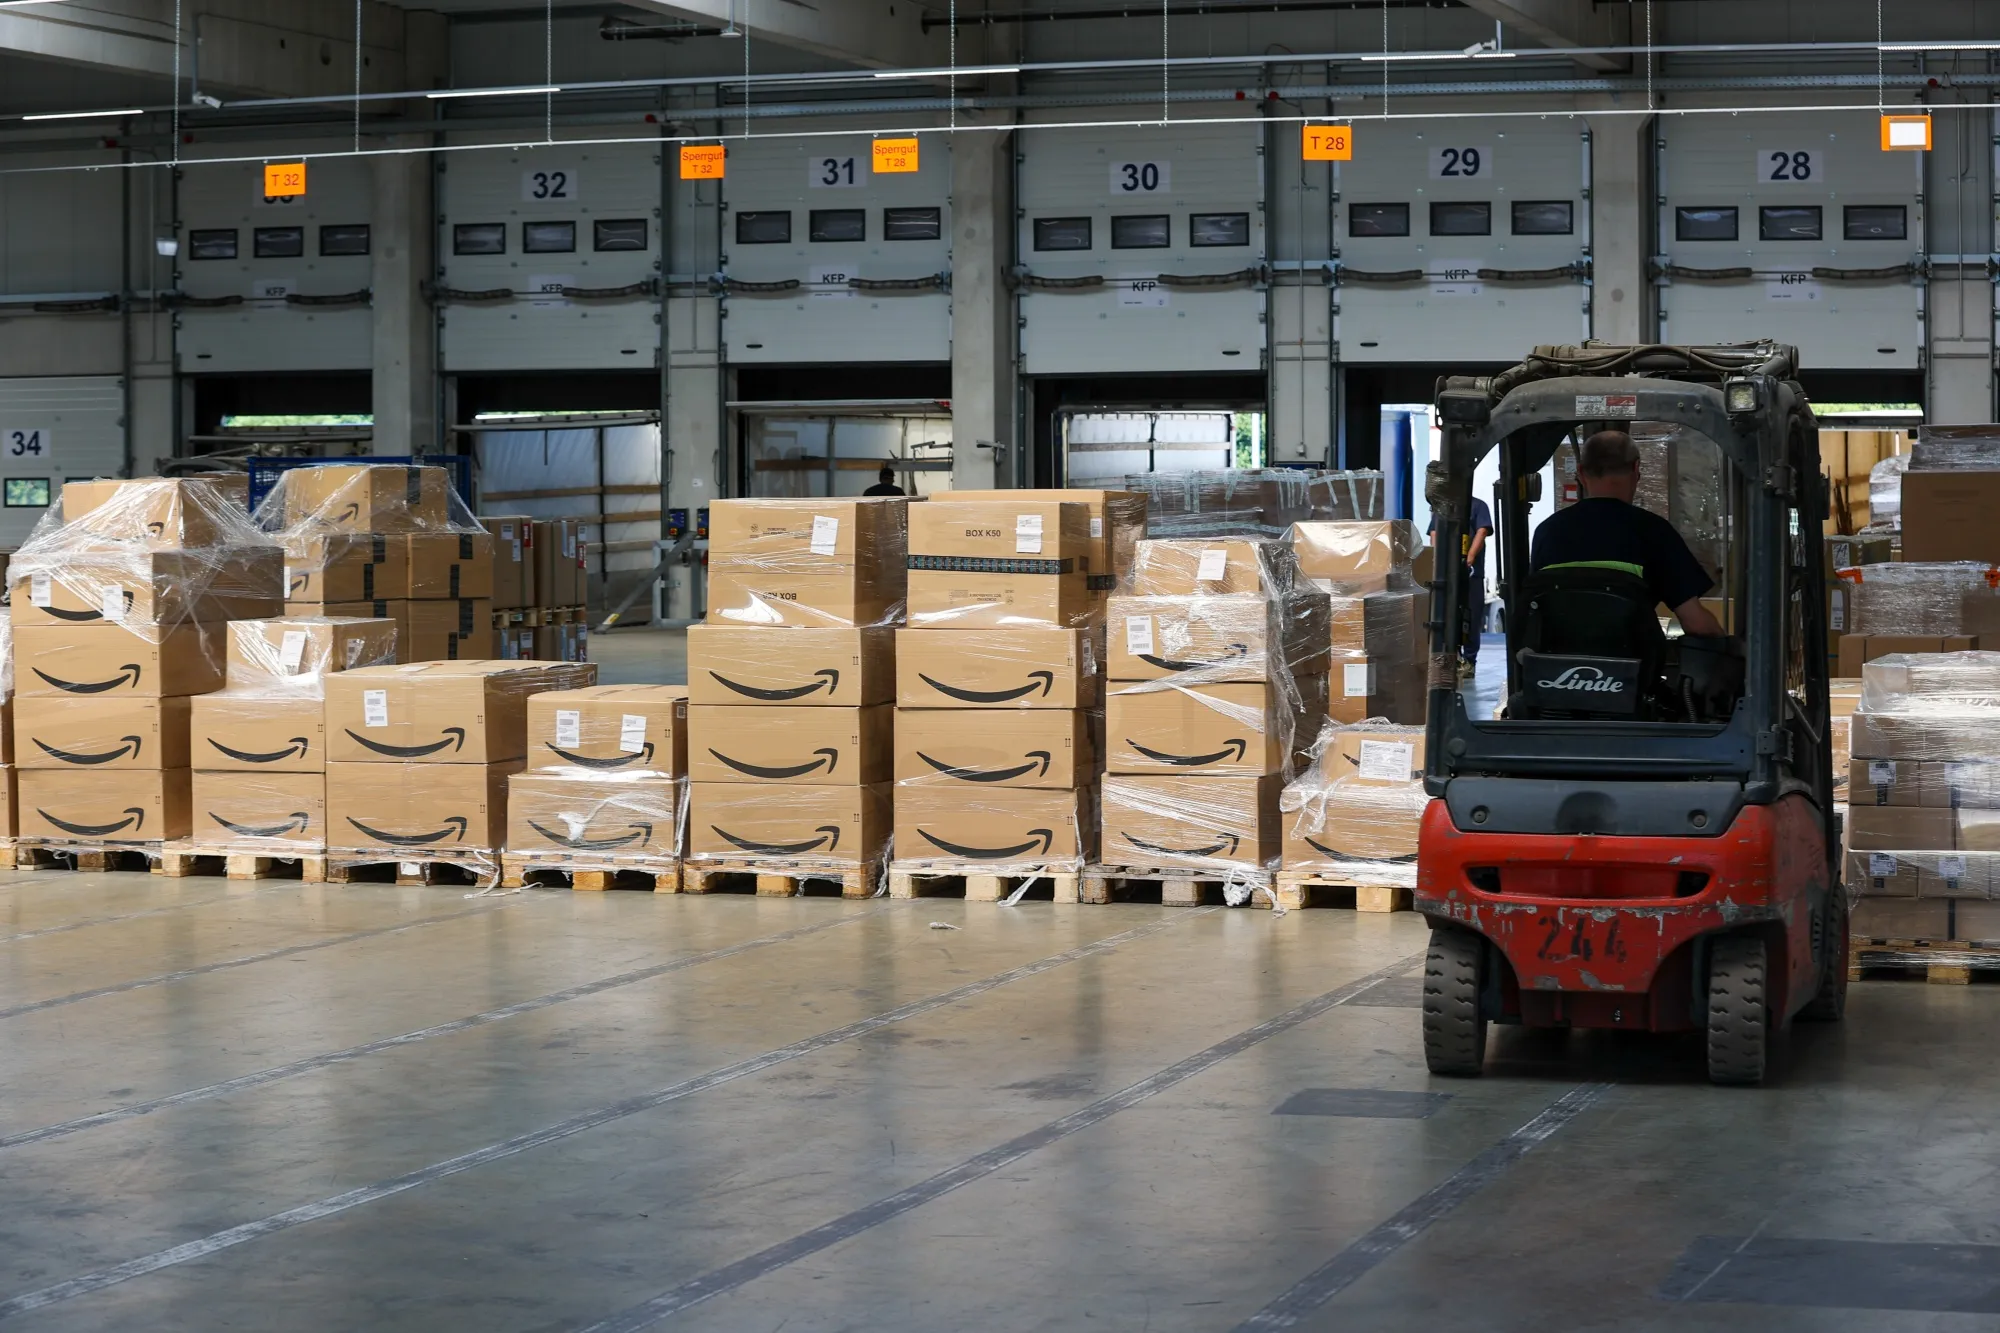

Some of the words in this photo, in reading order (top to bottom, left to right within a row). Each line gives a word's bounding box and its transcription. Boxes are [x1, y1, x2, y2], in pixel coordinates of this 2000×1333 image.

[1310, 136, 1320, 150] T
[1325, 136, 1345, 151] 28
[875, 144, 916, 156] Sperrgut
[682, 151, 723, 163] Sperrgut
[885, 158, 892, 167] T
[893, 158, 906, 167] 28
[1440, 147, 1480, 176] 29
[692, 164, 699, 173] T
[700, 164, 713, 174] 32
[822, 157, 854, 186] 31
[1770, 151, 1811, 181] 28
[271, 174, 279, 186] T
[283, 173, 300, 187] 32
[1121, 162, 1159, 192] 30
[532, 171, 567, 199] 32
[822, 273, 846, 285] KFP
[1445, 269, 1470, 280] KFP
[1780, 274, 1806, 285] KFP
[1132, 281, 1157, 292] KFP
[11, 430, 42, 457] 34
[965, 529, 984, 537] BOX
[985, 529, 1001, 537] K50
[780, 592, 797, 600] BOX
[1536, 665, 1624, 693] Linde
